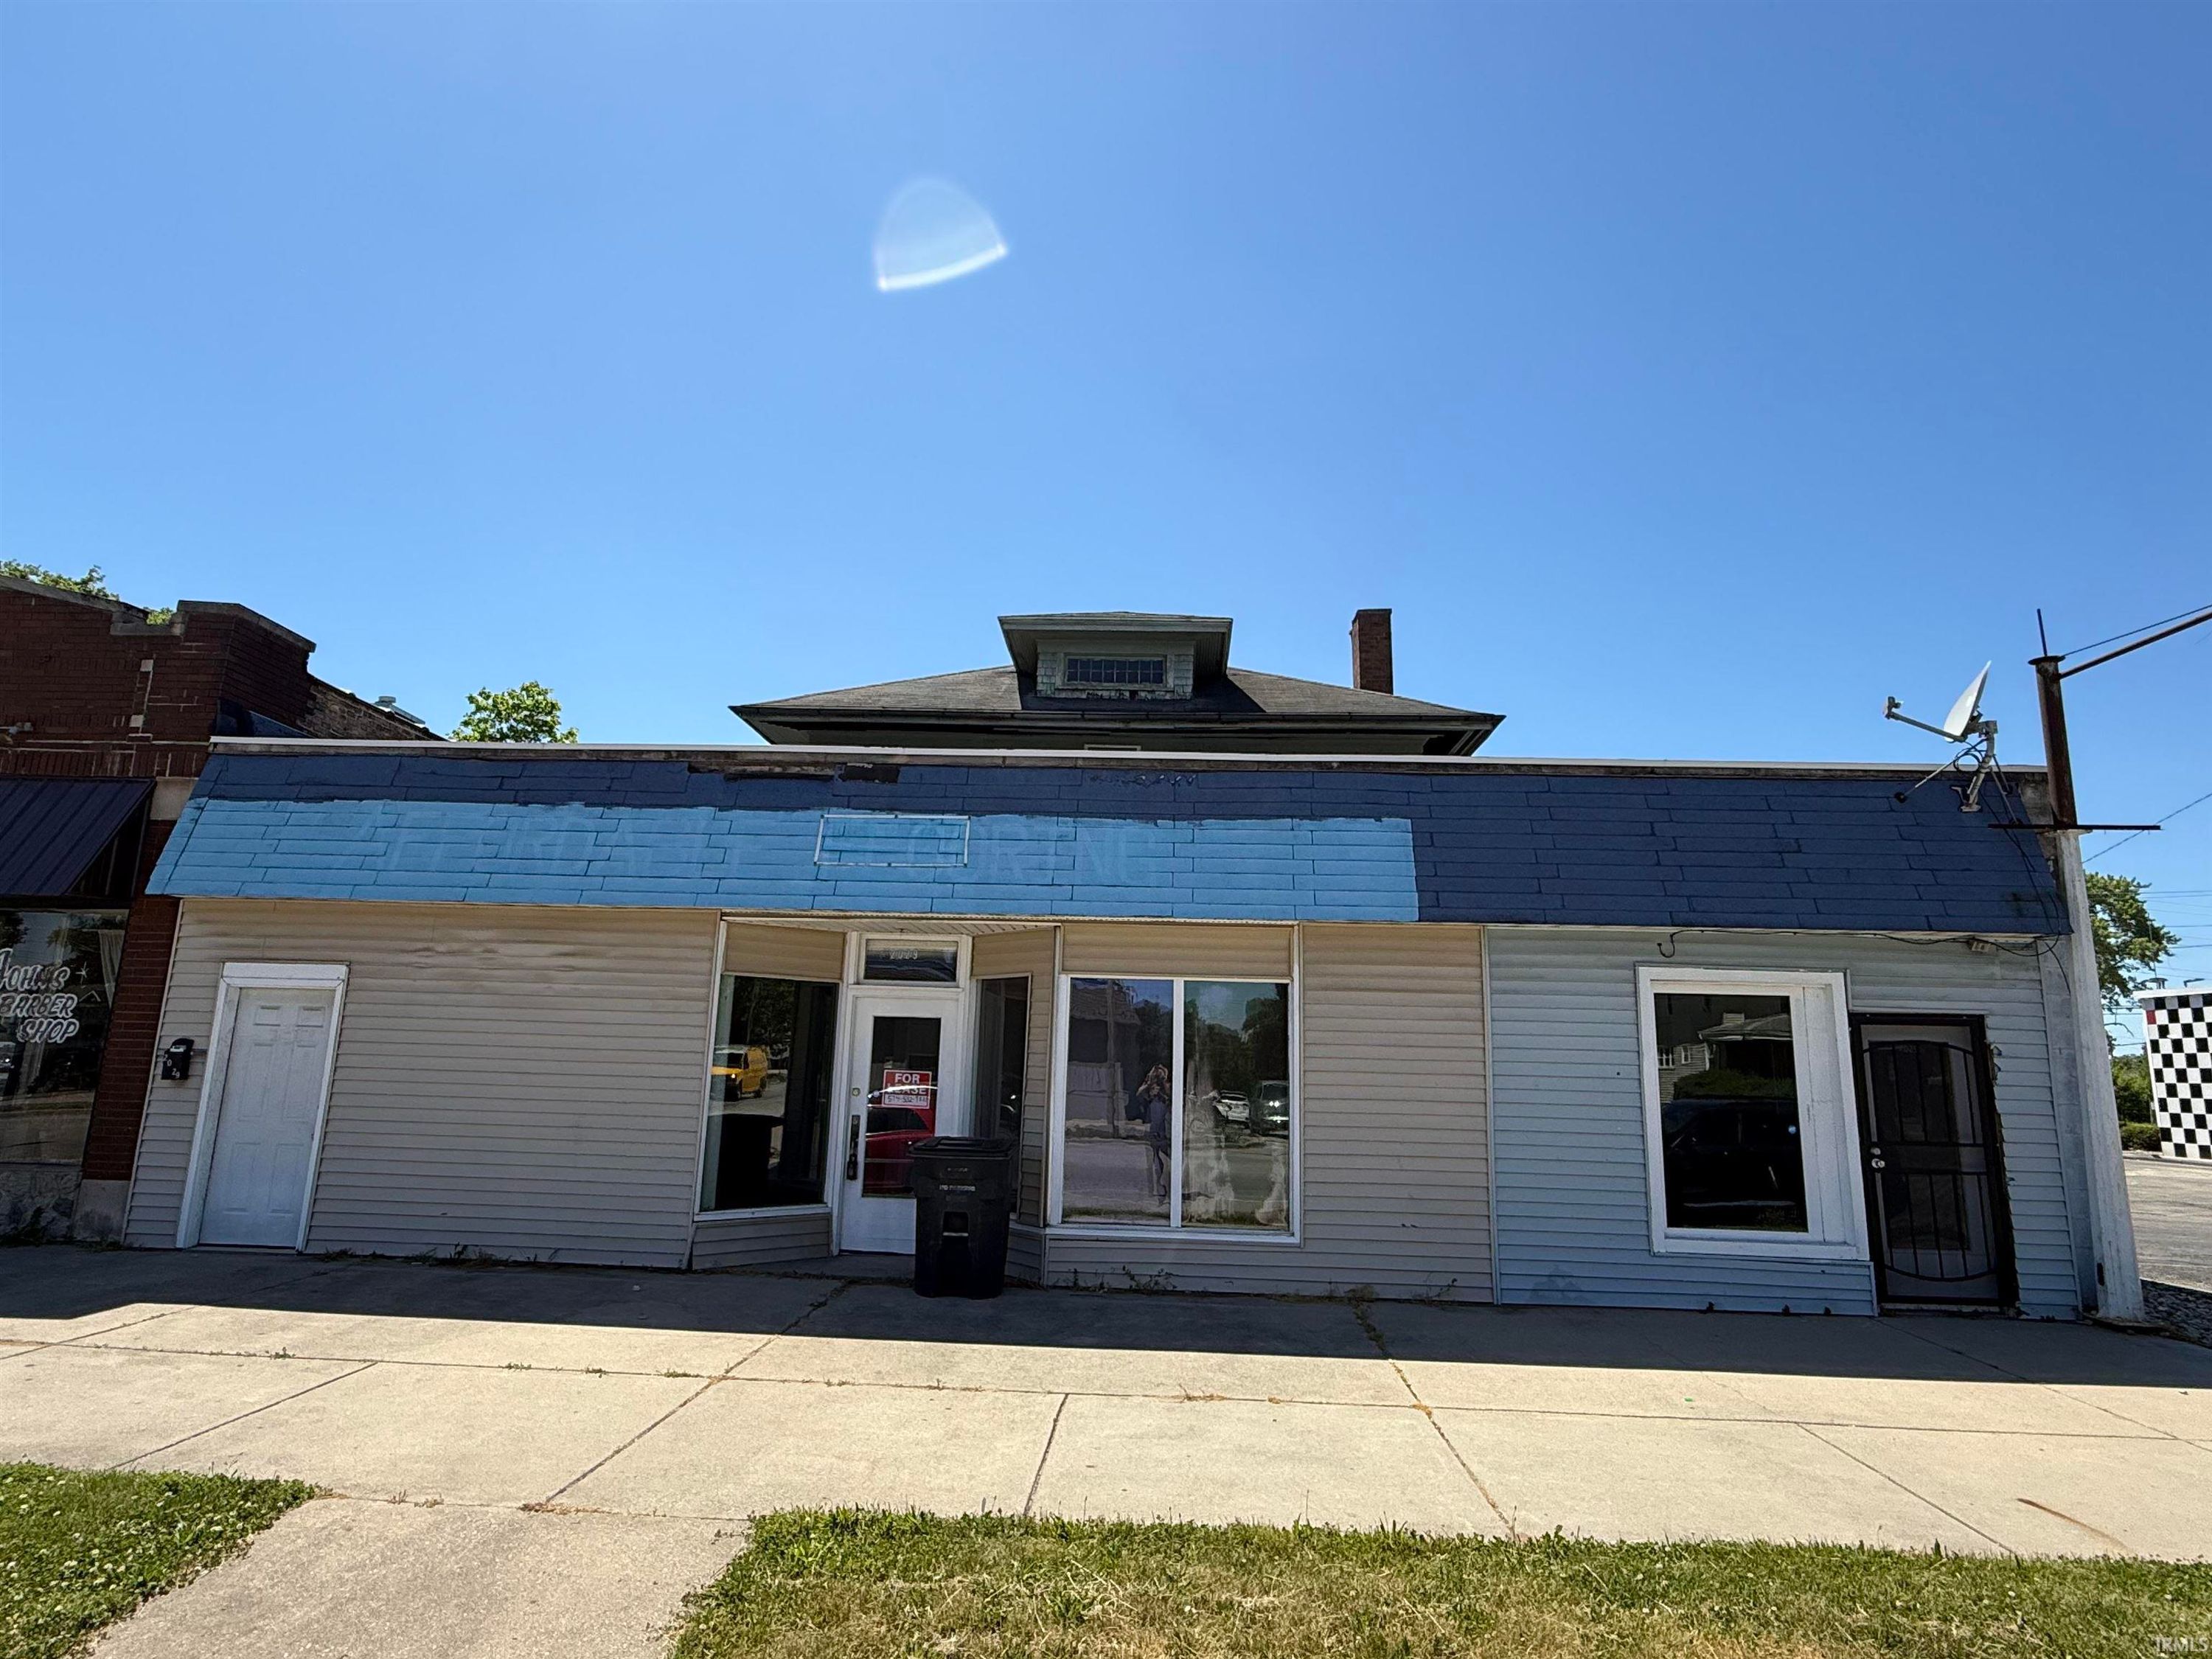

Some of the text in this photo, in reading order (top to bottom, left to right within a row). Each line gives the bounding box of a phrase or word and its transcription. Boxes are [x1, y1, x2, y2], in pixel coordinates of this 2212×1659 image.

[0, 992, 77, 1018] BARBER
[16, 1018, 80, 1044] SHOP
[894, 1073, 920, 1084] FOR
